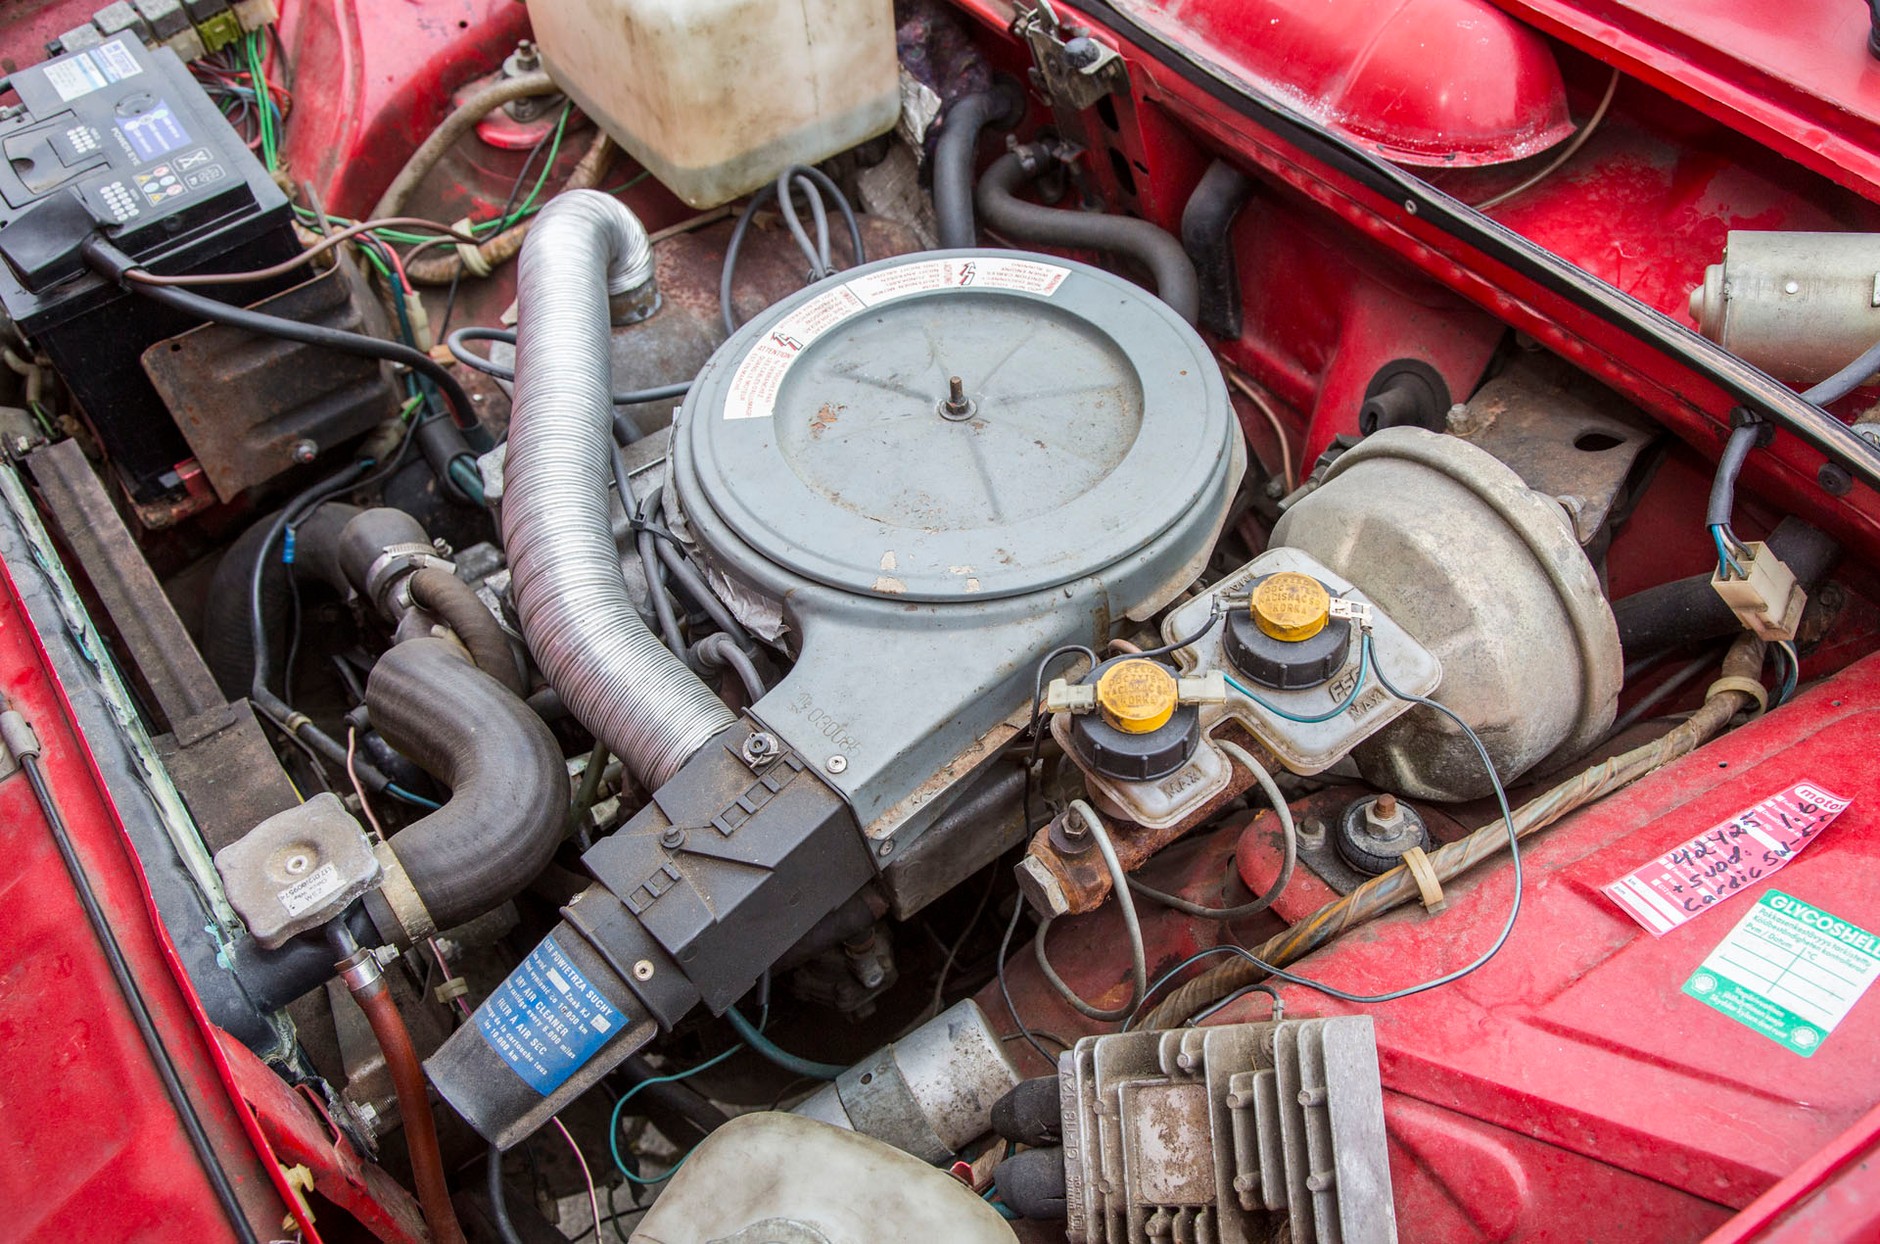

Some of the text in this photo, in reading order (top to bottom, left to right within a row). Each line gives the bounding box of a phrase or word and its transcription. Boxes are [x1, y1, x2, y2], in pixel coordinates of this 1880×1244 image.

[1348, 695, 1383, 720] MAX
[1161, 774, 1200, 798] MAX
[1780, 803, 1818, 830] 1.6
[1672, 812, 1761, 866] 42425
[1746, 922, 1762, 933] Pvm
[1768, 933, 1792, 948] Datum
[552, 951, 586, 991] POWIETRZA
[586, 991, 612, 1015] SUCHY
[516, 975, 568, 1036] DRY AIR CLEANER
[565, 993, 580, 1009] Znak
[580, 1008, 590, 1018] KJ
[497, 998, 512, 1016] FILTR
[509, 1015, 518, 1024] À
[516, 1024, 531, 1039] AIR
[530, 1038, 547, 1055] SEC
[527, 1010, 542, 1027] every
[542, 1025, 561, 1044] 6.000
[560, 1044, 575, 1058] miles
[578, 1024, 588, 1034] km
[491, 1029, 510, 1050] 10.000
[508, 1050, 518, 1061] km
[494, 1017, 500, 1025] de
[500, 1024, 506, 1033] la
[506, 1033, 533, 1062] cartouche
[534, 1062, 547, 1075] tous
[1061, 1070, 1076, 1100] 12V
